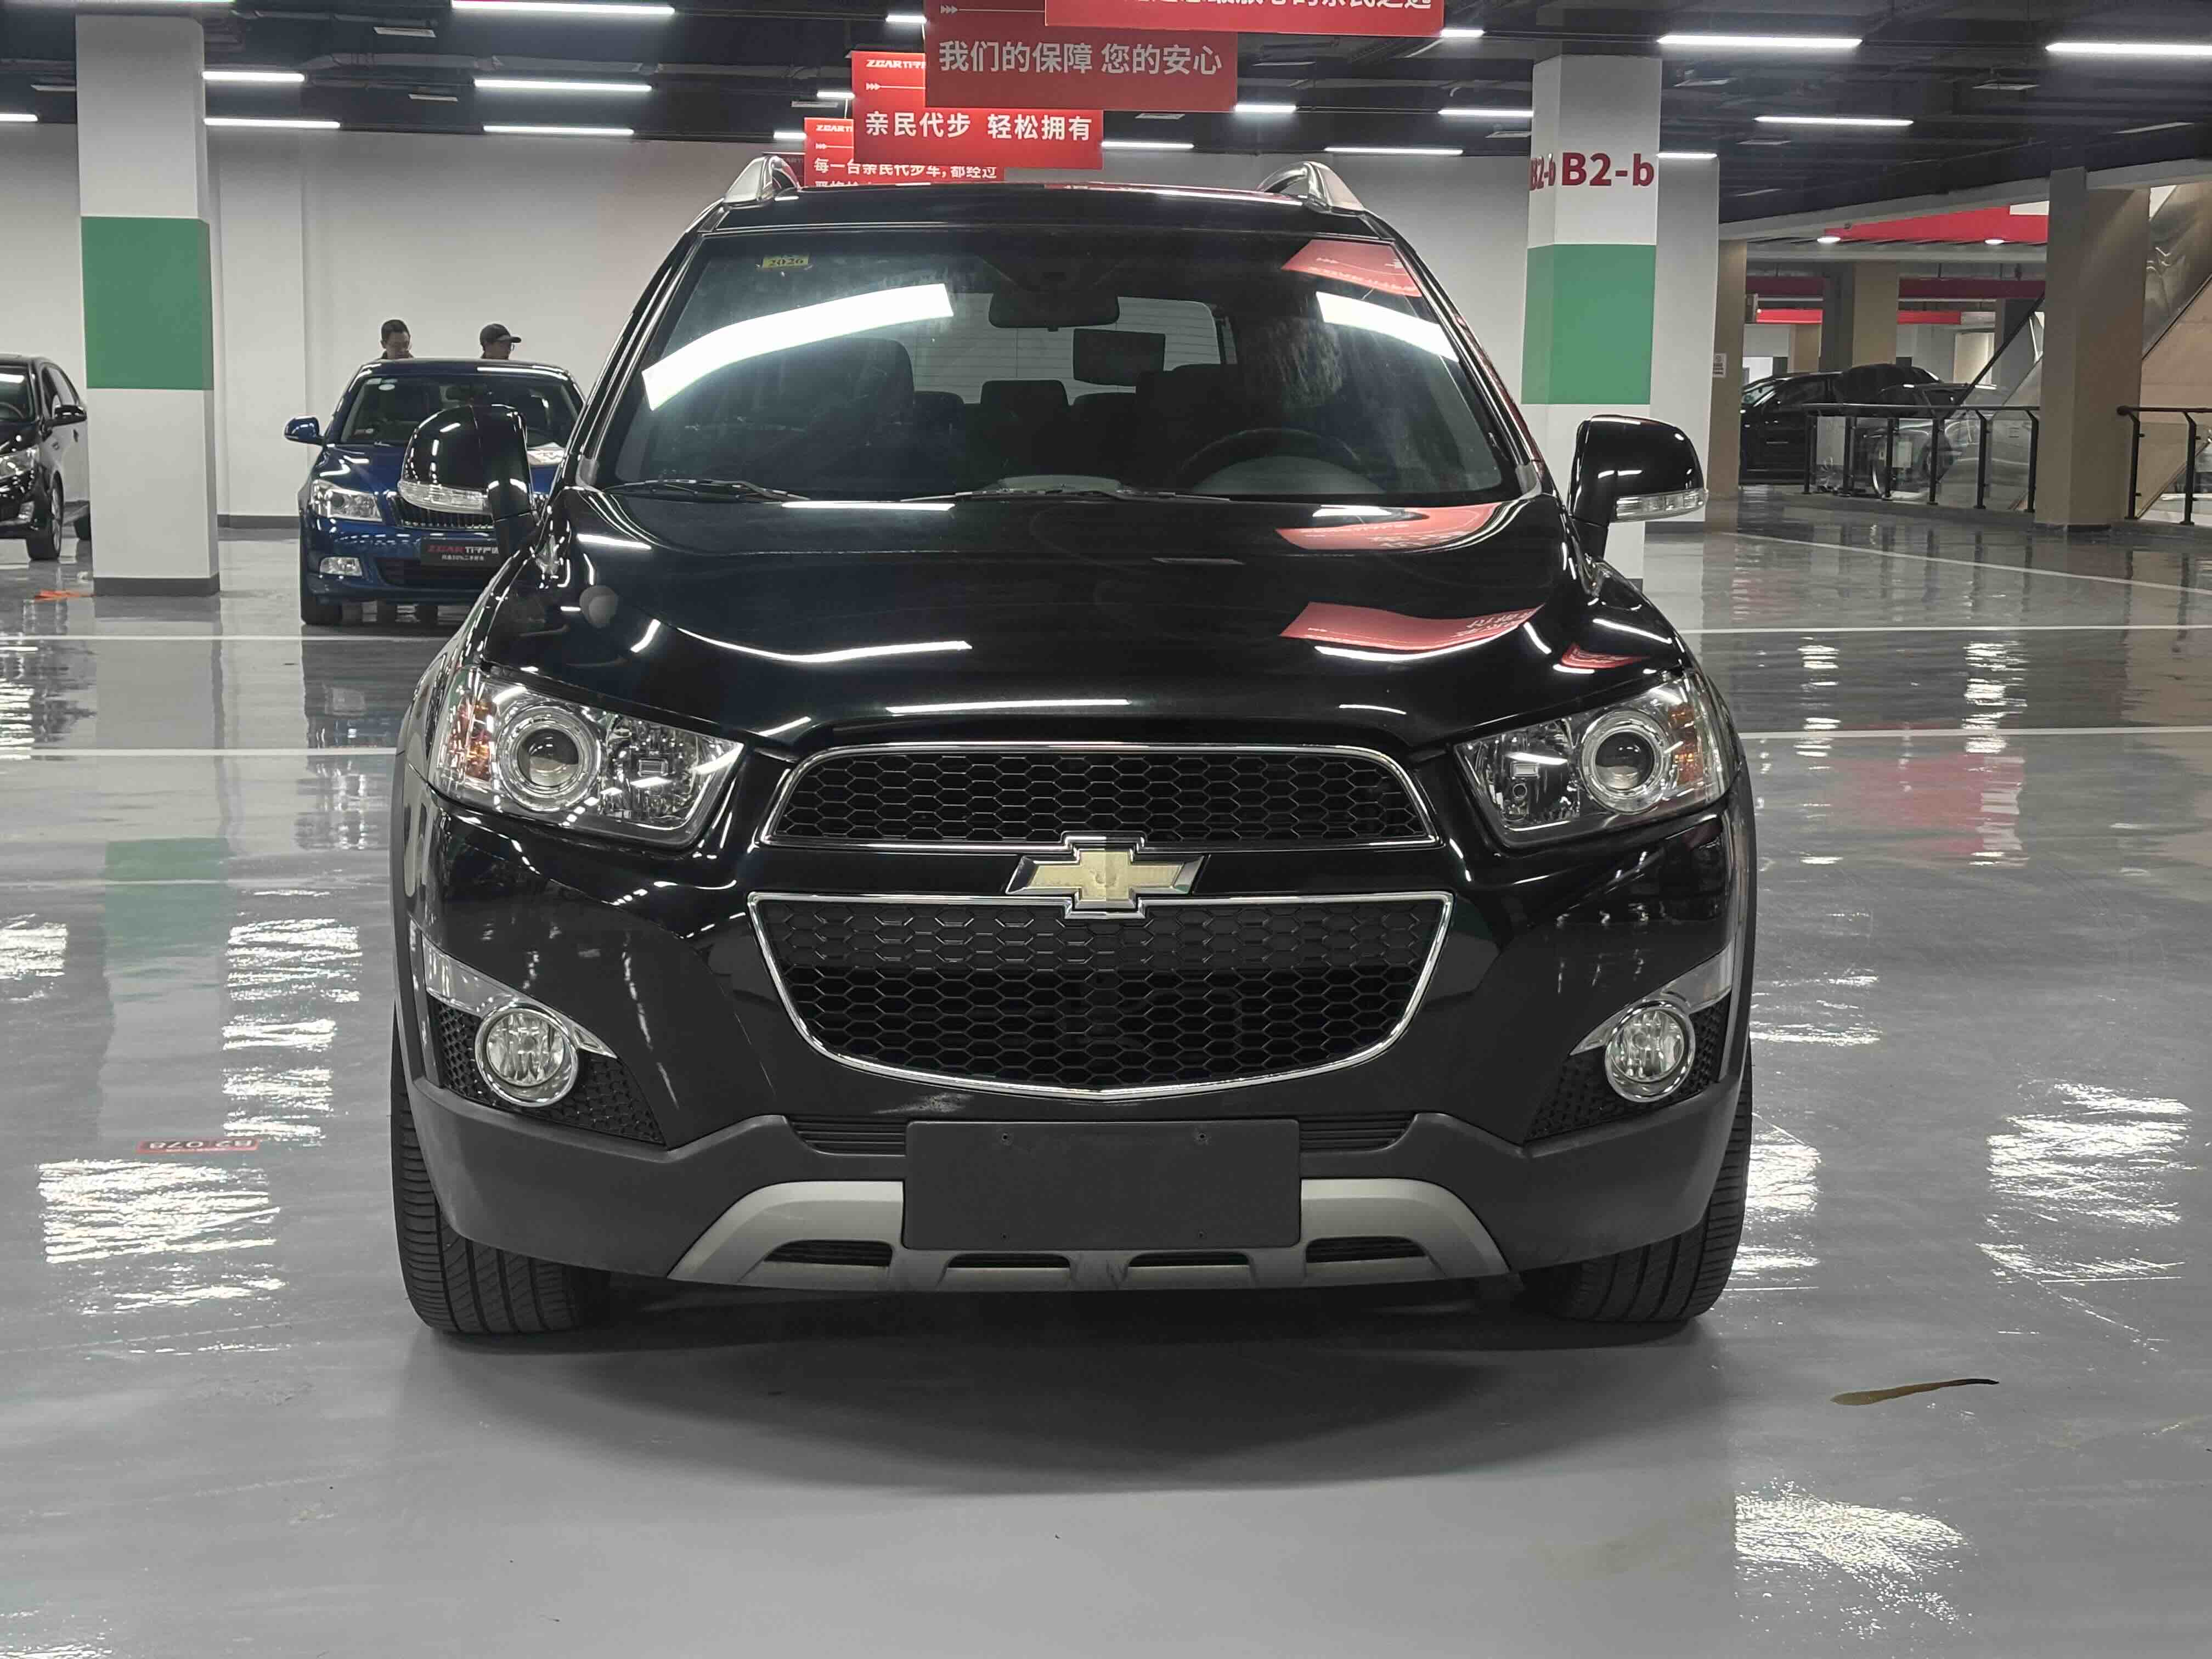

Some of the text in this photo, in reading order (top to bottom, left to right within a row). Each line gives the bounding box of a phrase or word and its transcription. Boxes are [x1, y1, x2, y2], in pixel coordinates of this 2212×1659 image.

[939, 41, 1223, 75] 我们的保障 您的安心
[865, 111, 1092, 140] 亲民代步 轻松拥有
[1562, 153, 1655, 187] B2-b
